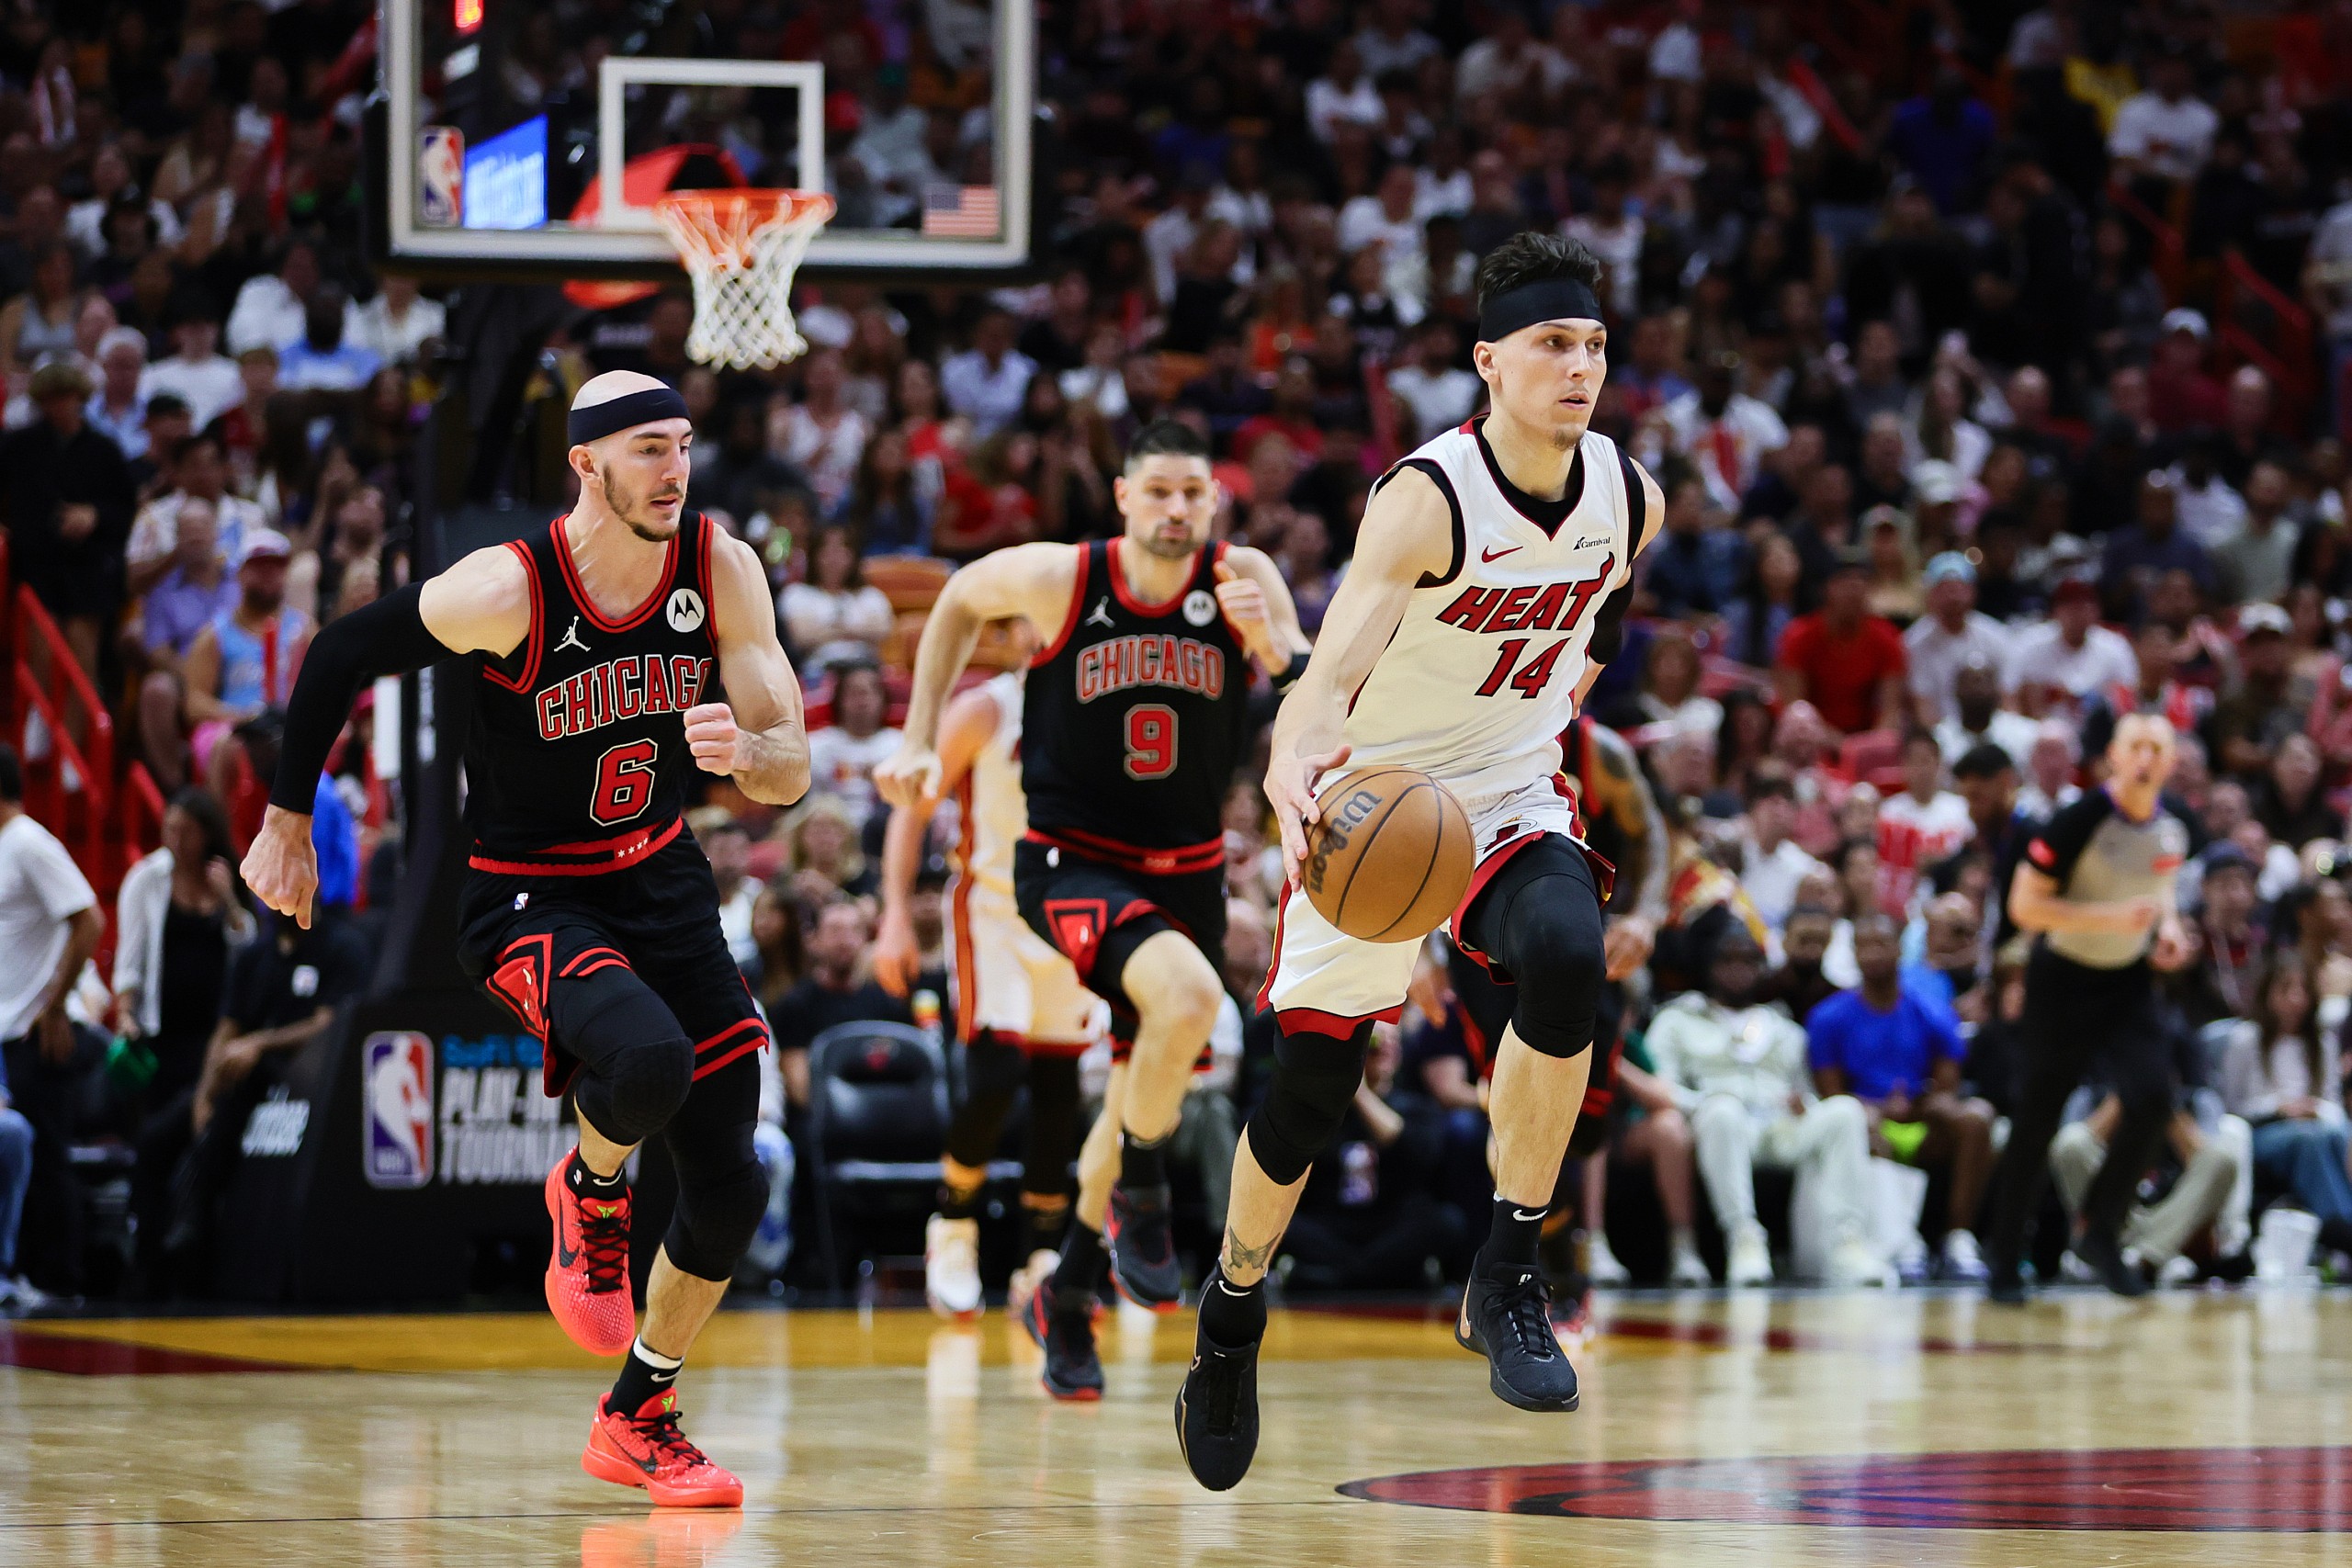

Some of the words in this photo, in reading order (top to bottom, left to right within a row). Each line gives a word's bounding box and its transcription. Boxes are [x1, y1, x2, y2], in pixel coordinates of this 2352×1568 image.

[1581, 536, 1611, 548] Carnival
[1435, 551, 1614, 634] HEAT
[1076, 634, 1225, 705] CHICAGO
[1474, 637, 1572, 699] 14
[1124, 704, 1179, 781] 9
[590, 738, 658, 827] 6
[1309, 789, 1384, 895] Wilson
